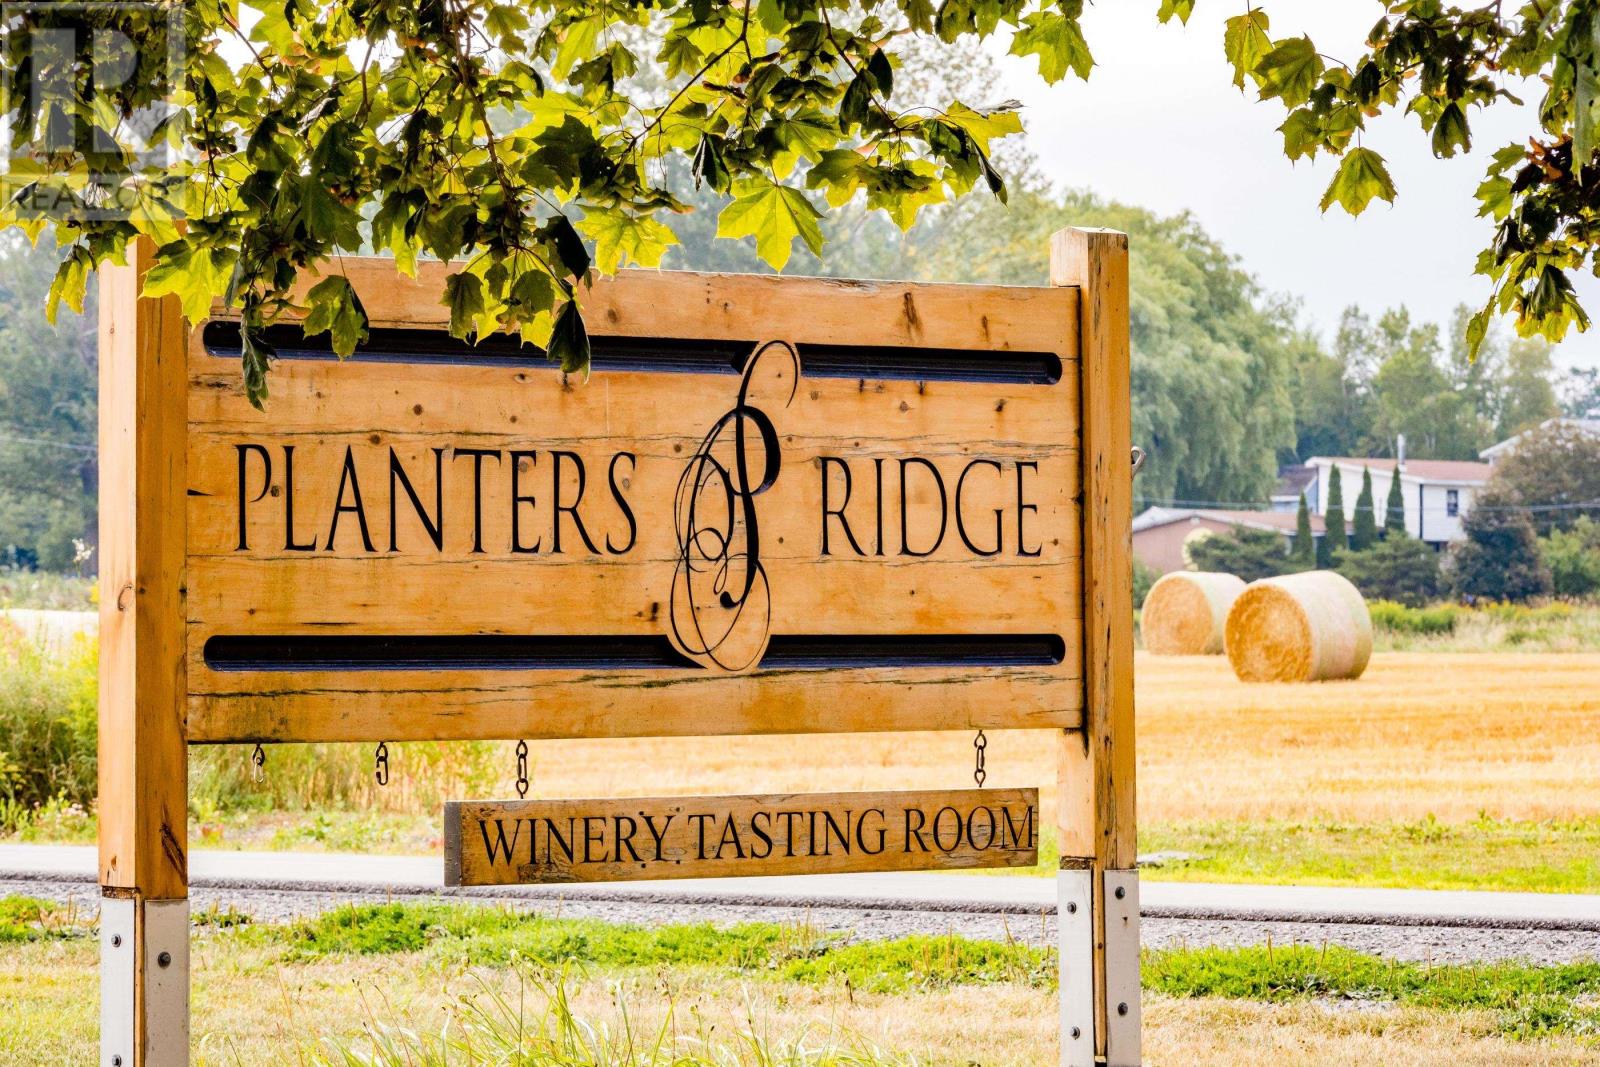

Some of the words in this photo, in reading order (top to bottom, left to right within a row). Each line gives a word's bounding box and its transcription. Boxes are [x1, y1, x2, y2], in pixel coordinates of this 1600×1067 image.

[234, 444, 637, 556] PLANTERS
[819, 456, 1042, 557] RIDGE
[478, 813, 676, 867] WINERY
[687, 808, 887, 860] TASTING
[902, 804, 1037, 853] ROOM
